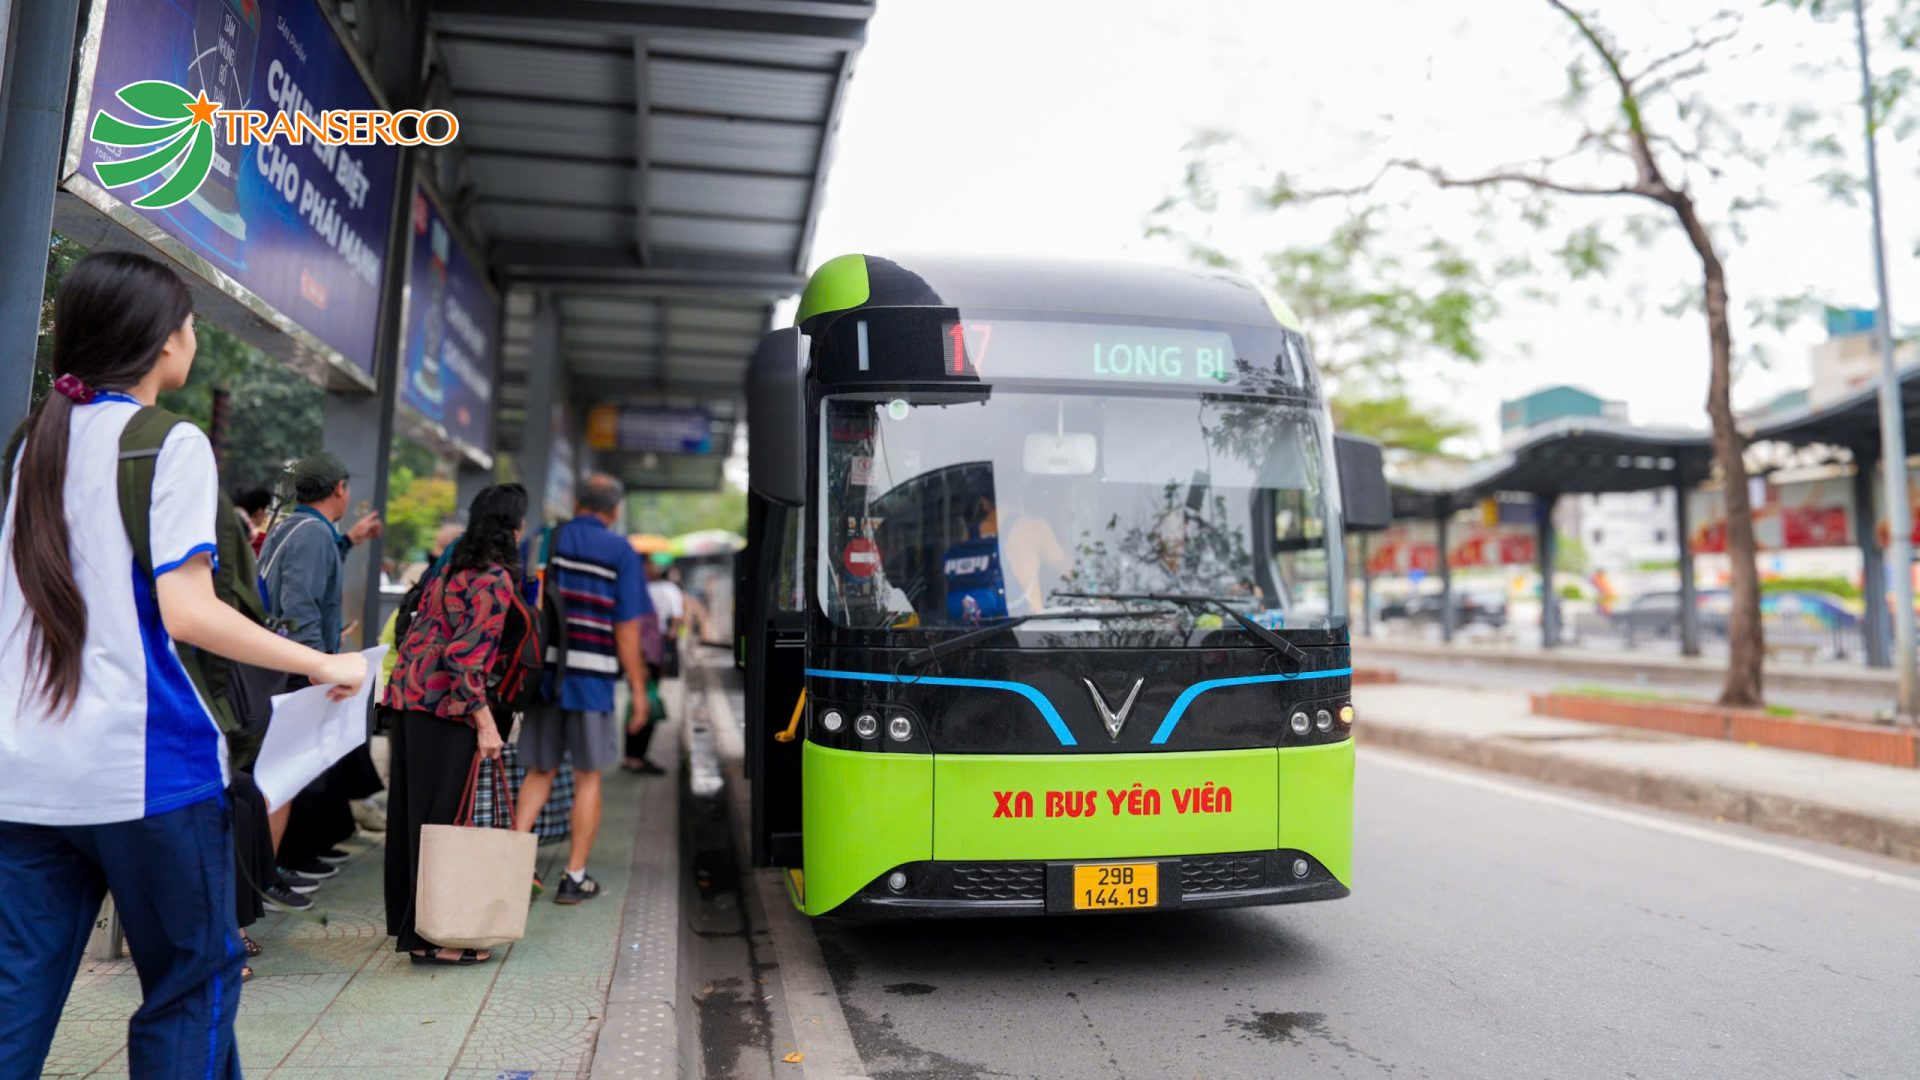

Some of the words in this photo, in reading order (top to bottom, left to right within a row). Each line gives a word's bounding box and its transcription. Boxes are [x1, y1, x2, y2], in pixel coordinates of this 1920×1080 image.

[257, 141, 299, 202] CHO
[299, 179, 341, 247] PHÁI
[948, 323, 992, 374] 17
[1093, 343, 1182, 377] LONG
[992, 790, 1034, 818] XN
[1045, 790, 1098, 818] BUS
[1106, 782, 1161, 816] YÊN
[1171, 781, 1232, 815] VIÊN
[1098, 867, 1134, 886] 29B
[1085, 887, 1149, 907] 144.19
